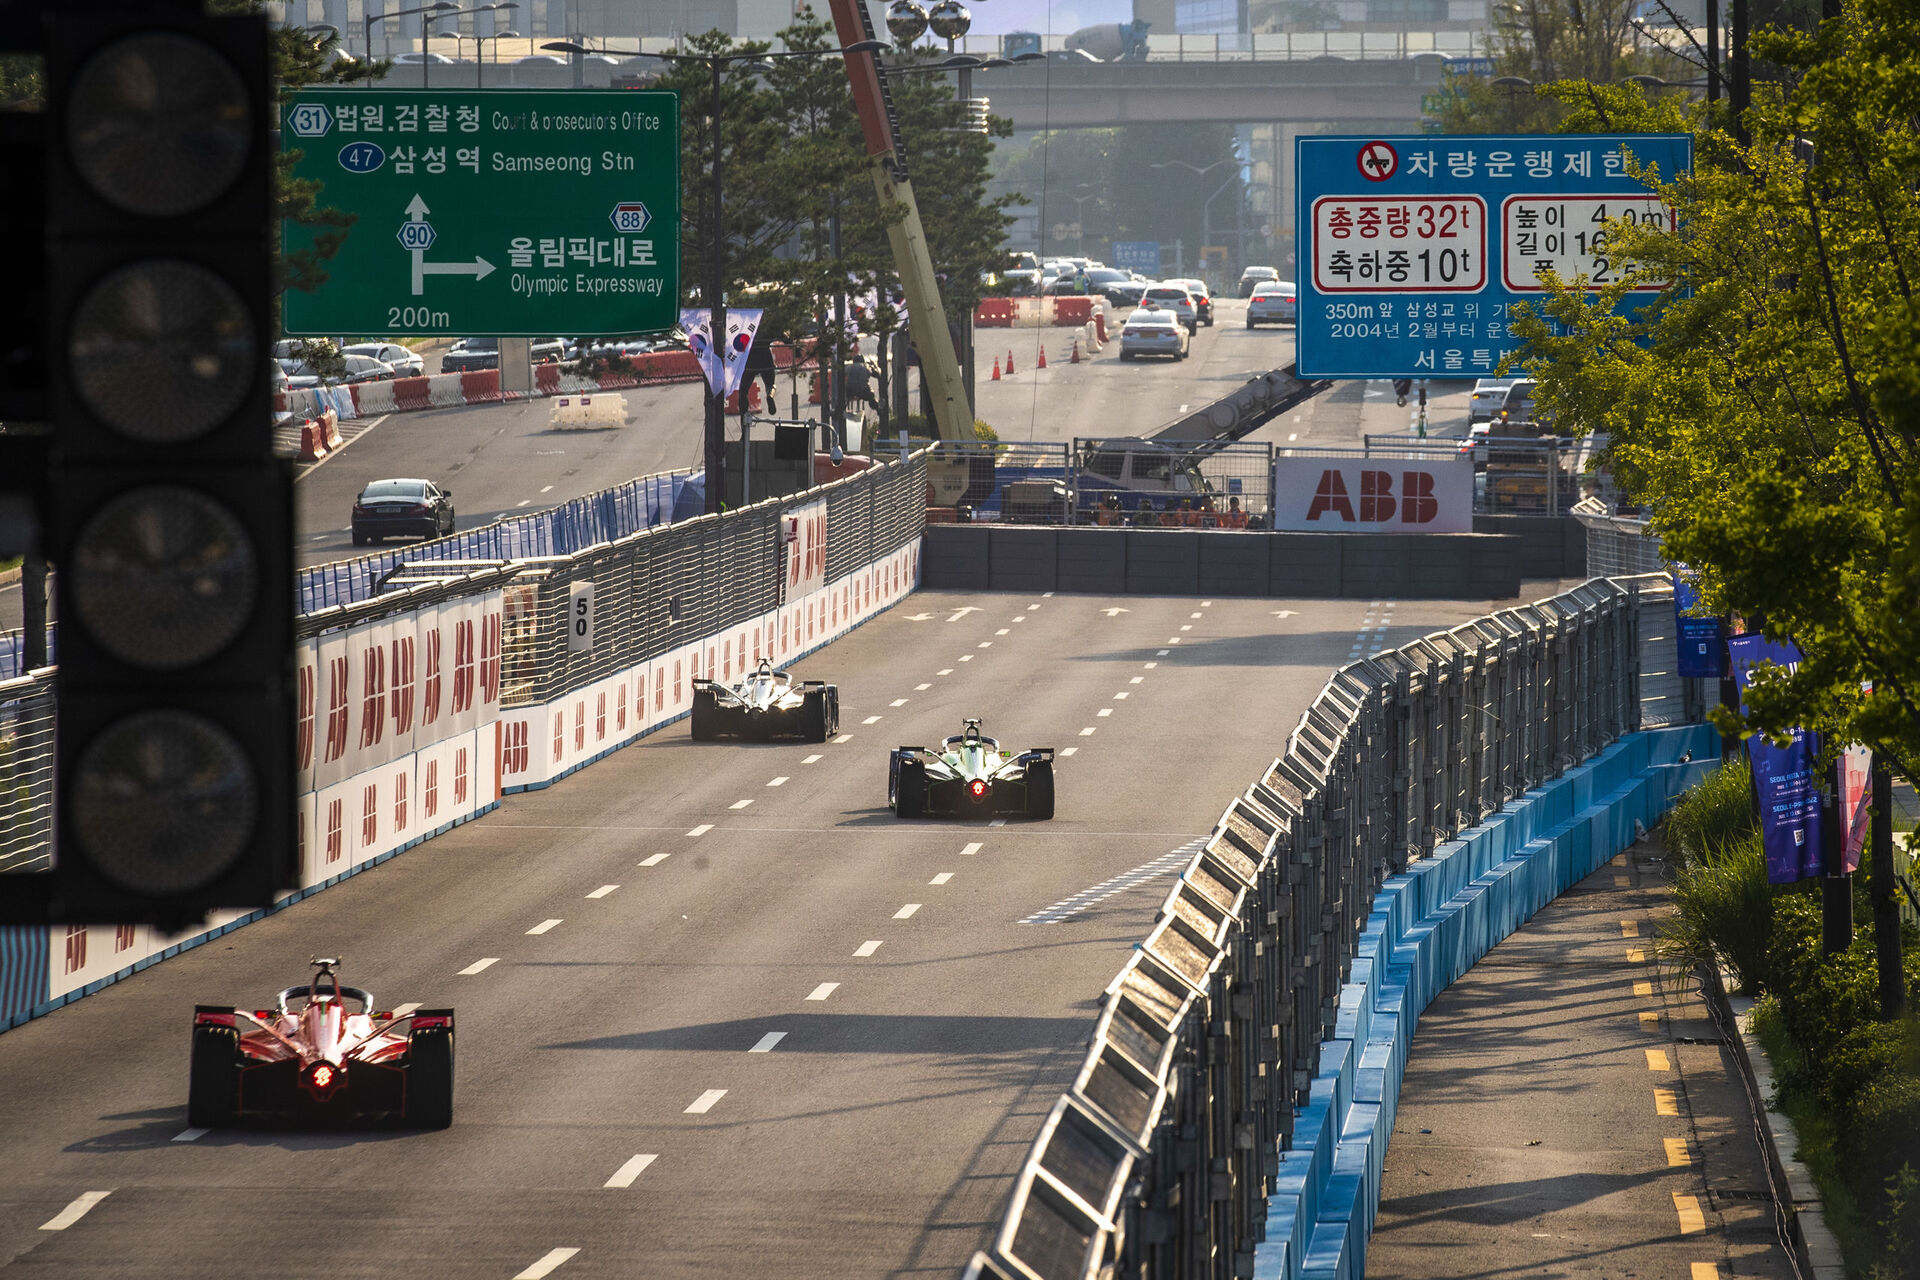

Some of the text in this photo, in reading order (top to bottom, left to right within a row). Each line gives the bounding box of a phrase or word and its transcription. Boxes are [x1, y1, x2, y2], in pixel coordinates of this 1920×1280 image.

[299, 109, 321, 131] 31
[335, 104, 480, 133] 법원.검찰청
[530, 111, 539, 130] &
[349, 148, 374, 167] 47
[492, 151, 635, 176] Samseong Stn
[620, 212, 640, 228] 88
[1515, 204, 1565, 229] 높이
[406, 226, 428, 245] 90
[1516, 231, 1565, 256] 길이
[507, 237, 657, 268] 올림픽대로
[511, 273, 664, 298] Olympic Expressway
[387, 306, 450, 327] 200m
[1325, 303, 1374, 320] 350m
[1378, 302, 1393, 318] 앞
[1406, 302, 1456, 318] 삼성교
[1330, 322, 1400, 339] 2004년
[1408, 321, 1475, 339] 2월부터
[1306, 469, 1439, 524] ABB
[576, 598, 588, 637] 50
[502, 721, 528, 775] ABB
